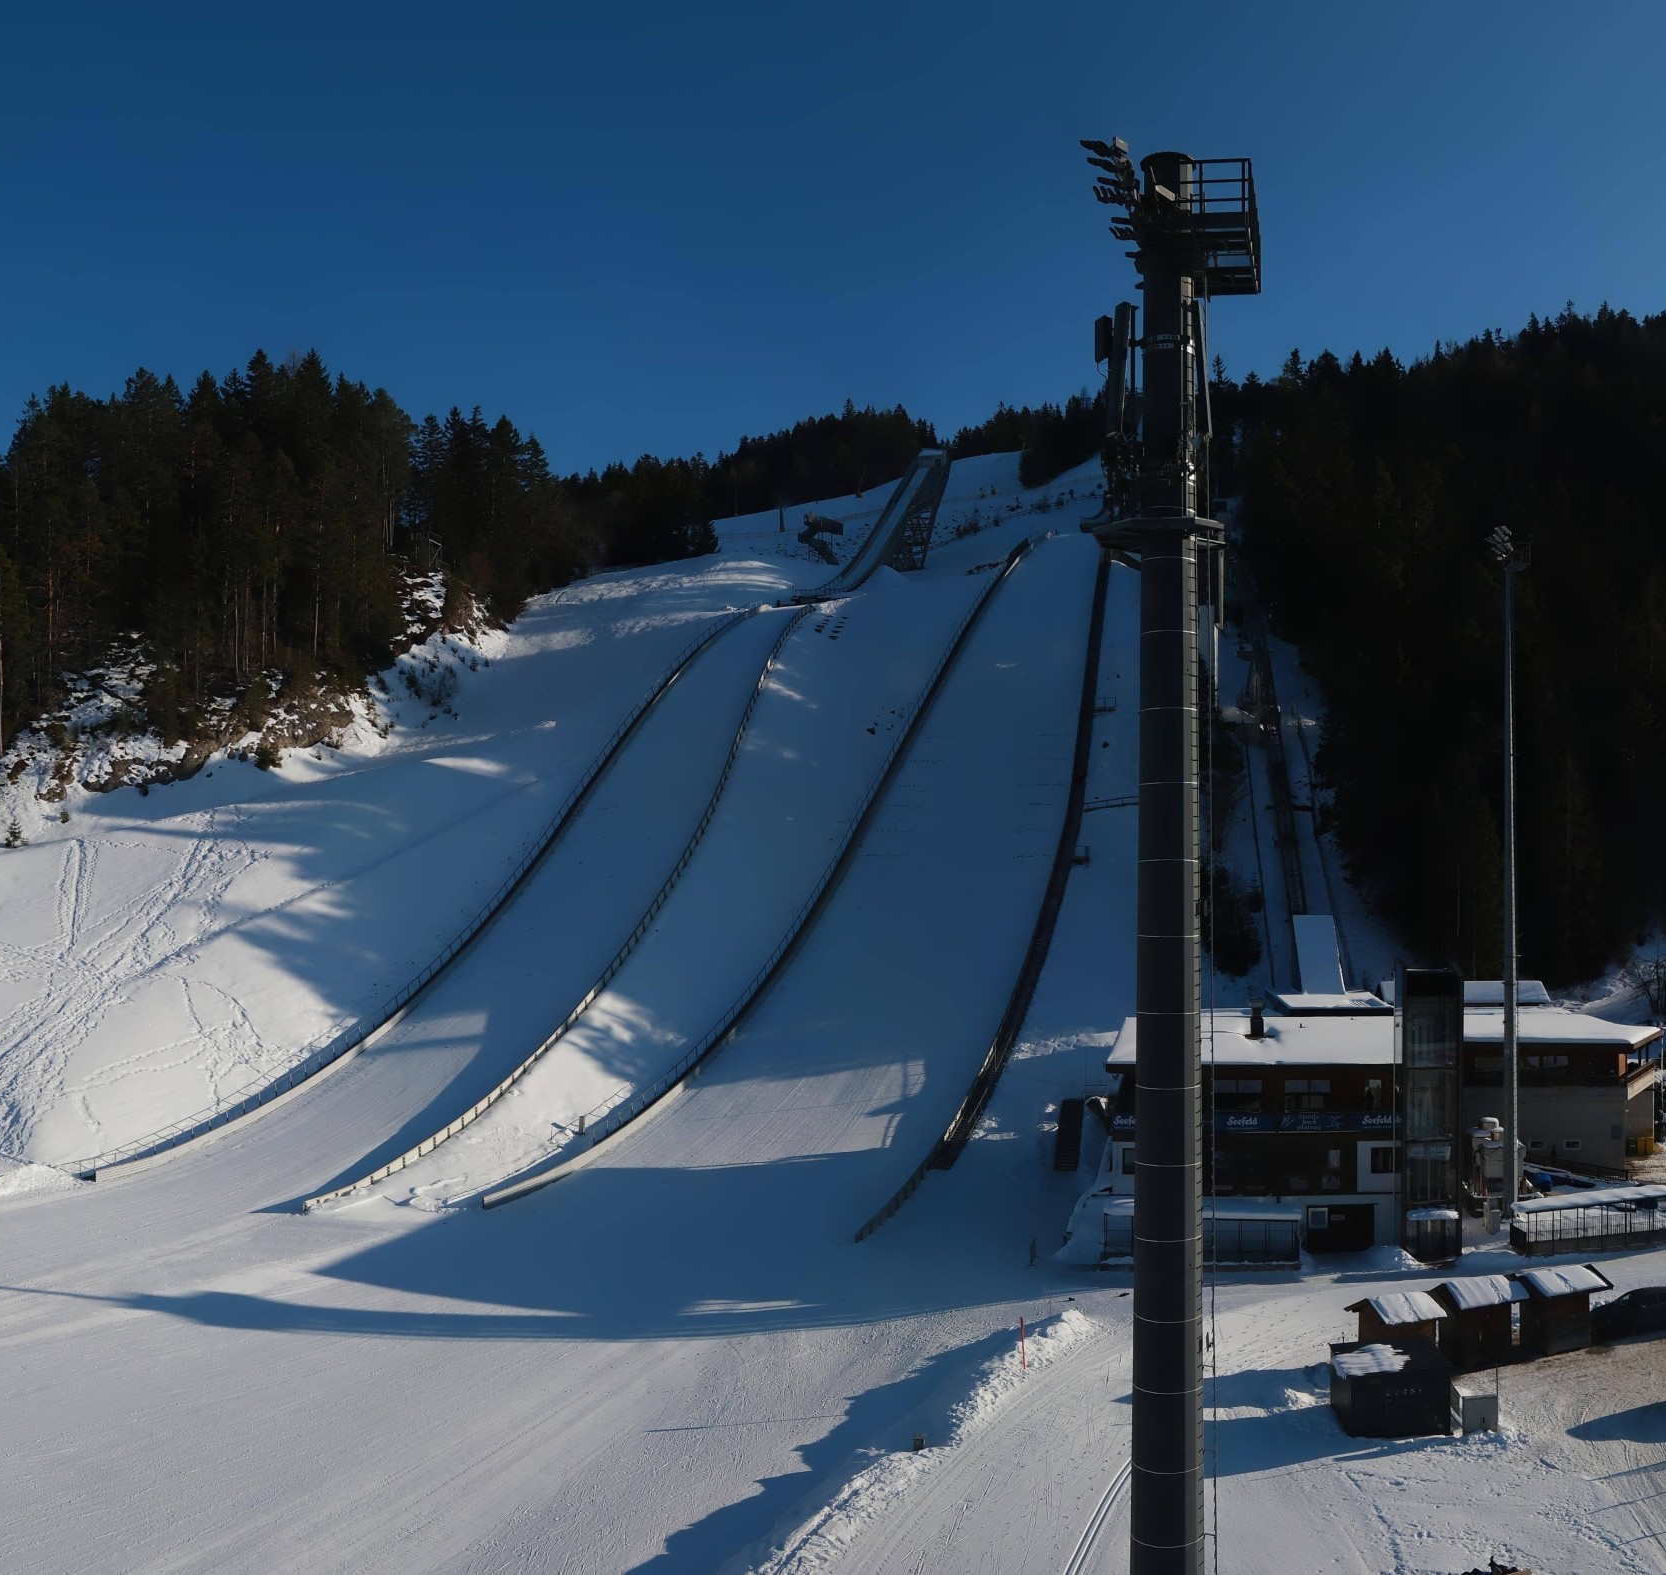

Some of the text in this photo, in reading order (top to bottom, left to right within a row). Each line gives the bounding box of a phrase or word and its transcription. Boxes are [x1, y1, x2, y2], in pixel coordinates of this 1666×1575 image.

[1113, 1115, 1135, 1127] Seefe
[1227, 1116, 1258, 1127] Seefeld
[1362, 1115, 1392, 1127] Seefeld
